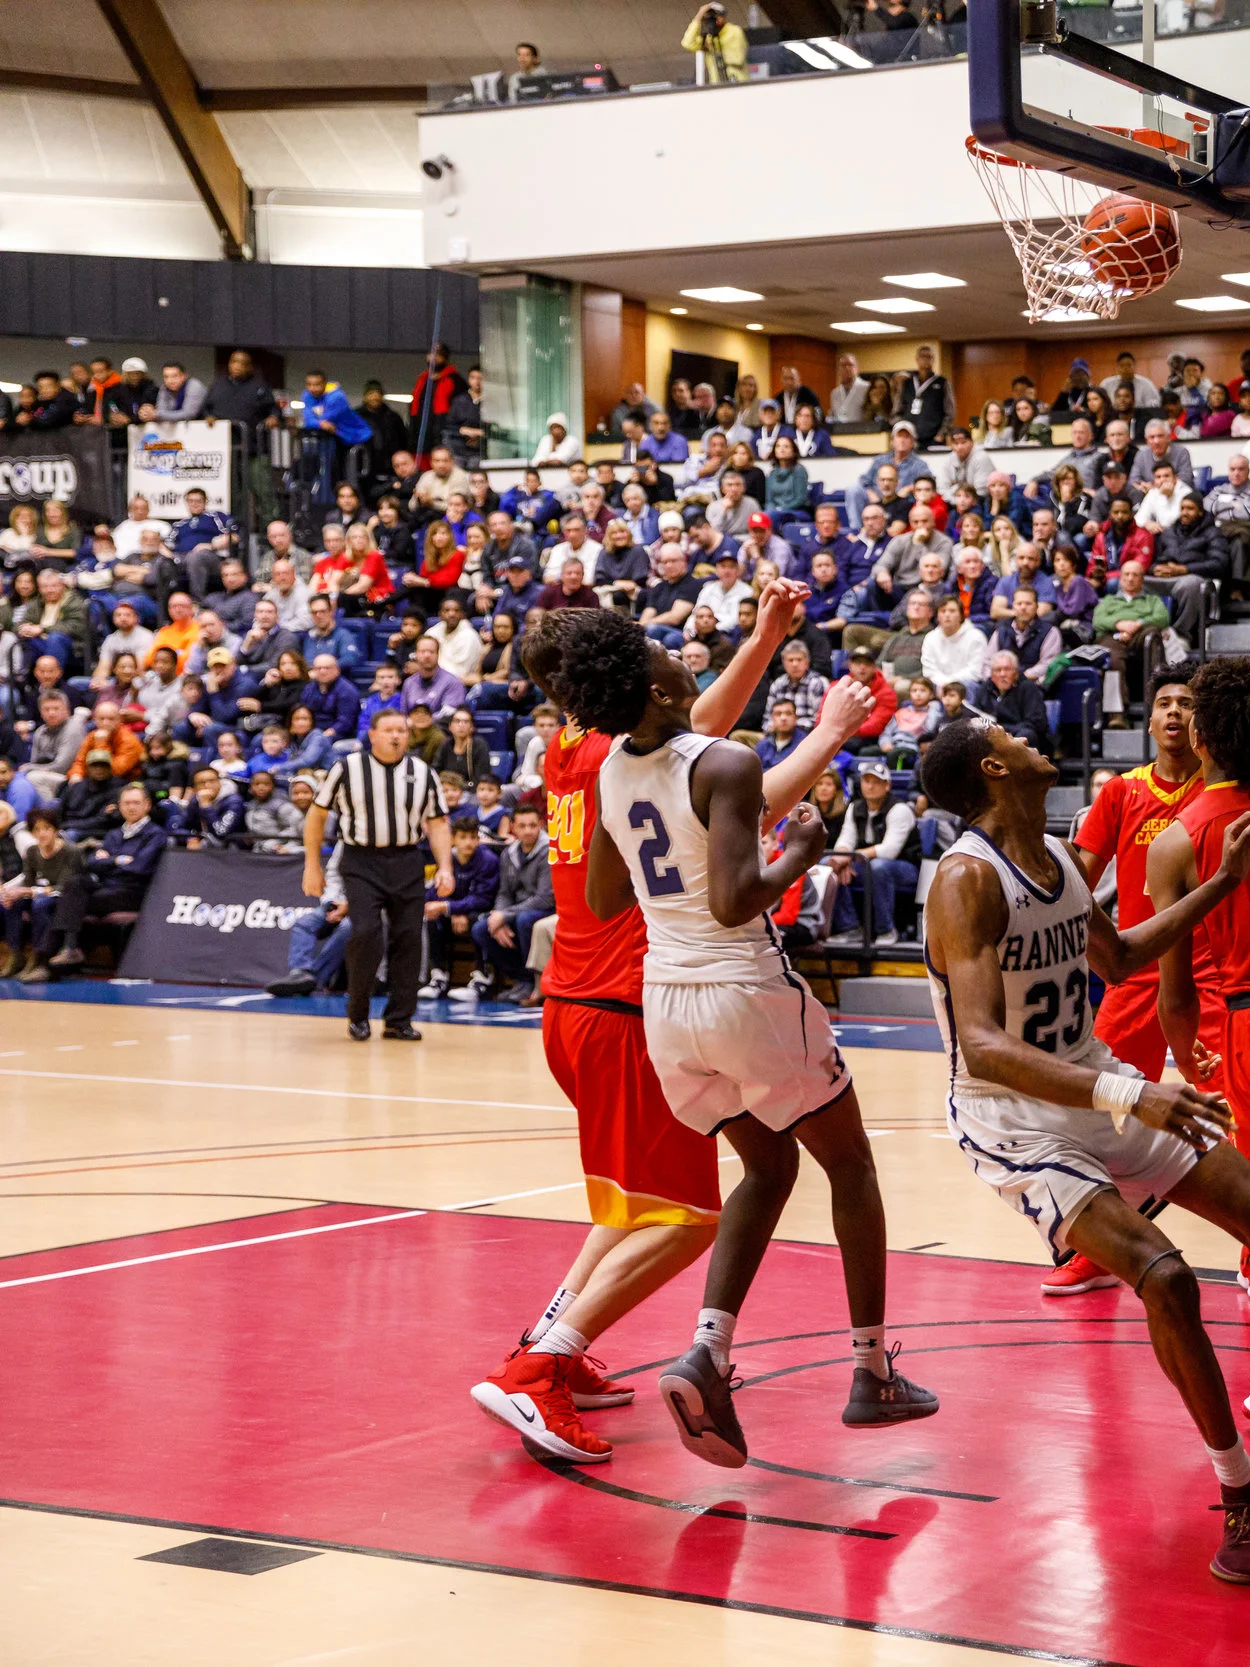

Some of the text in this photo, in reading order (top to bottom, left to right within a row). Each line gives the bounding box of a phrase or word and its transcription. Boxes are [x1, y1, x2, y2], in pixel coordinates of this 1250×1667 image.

[628, 800, 687, 897] 2
[1000, 911, 1091, 972] RANNE
[1022, 967, 1088, 1054] 23
